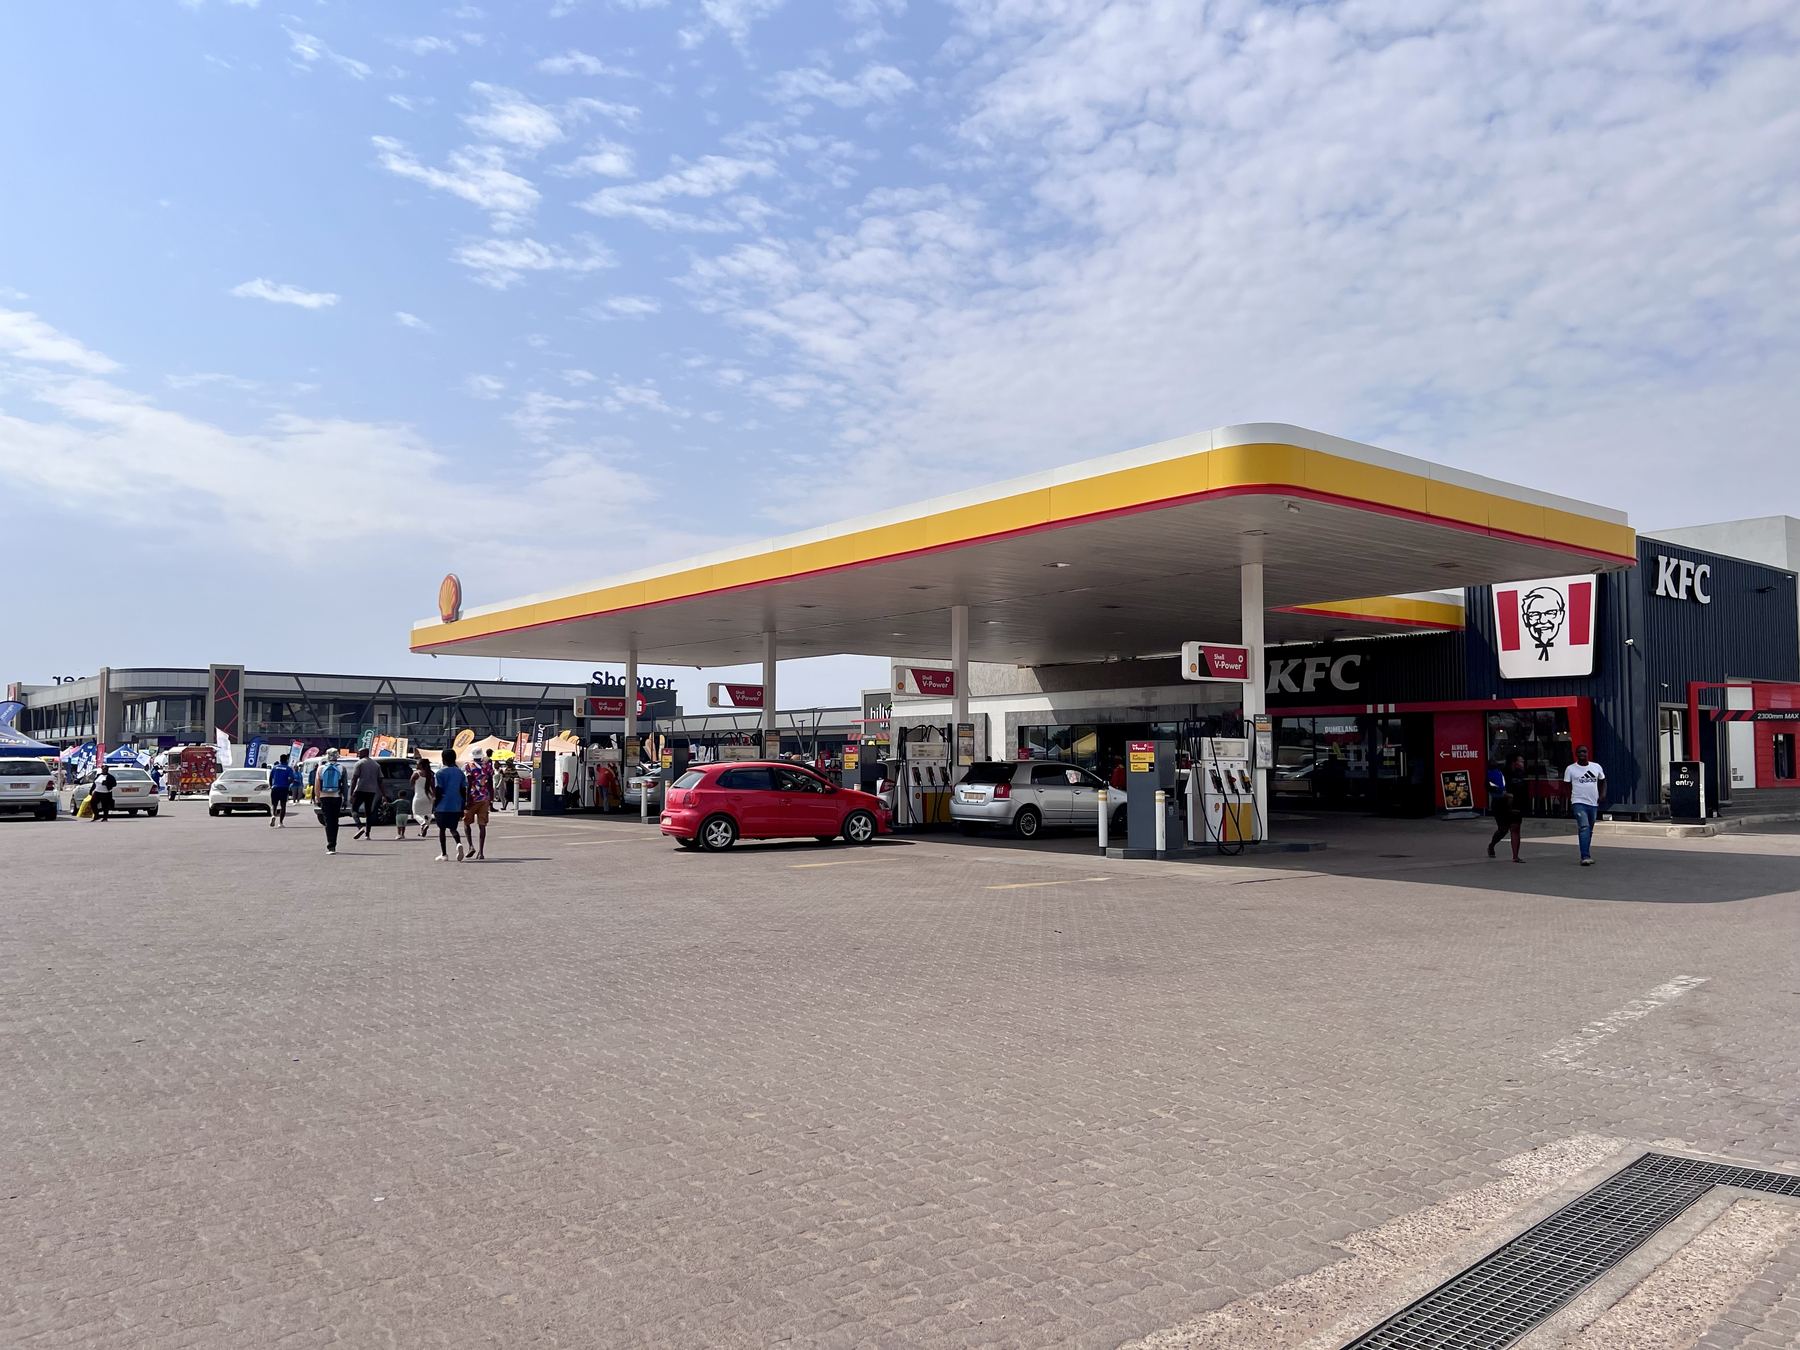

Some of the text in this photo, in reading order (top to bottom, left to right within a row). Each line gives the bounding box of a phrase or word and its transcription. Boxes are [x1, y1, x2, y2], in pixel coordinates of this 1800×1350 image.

[1656, 554, 1711, 604] KFC
[1214, 660, 1242, 670] V-Power
[1266, 654, 1362, 694] KFC
[922, 680, 949, 689] V-Power
[535, 723, 546, 752] Orange
[247, 742, 257, 765] OREO
[1451, 750, 1478, 759] WELCOME
[1675, 779, 1694, 787] entry
